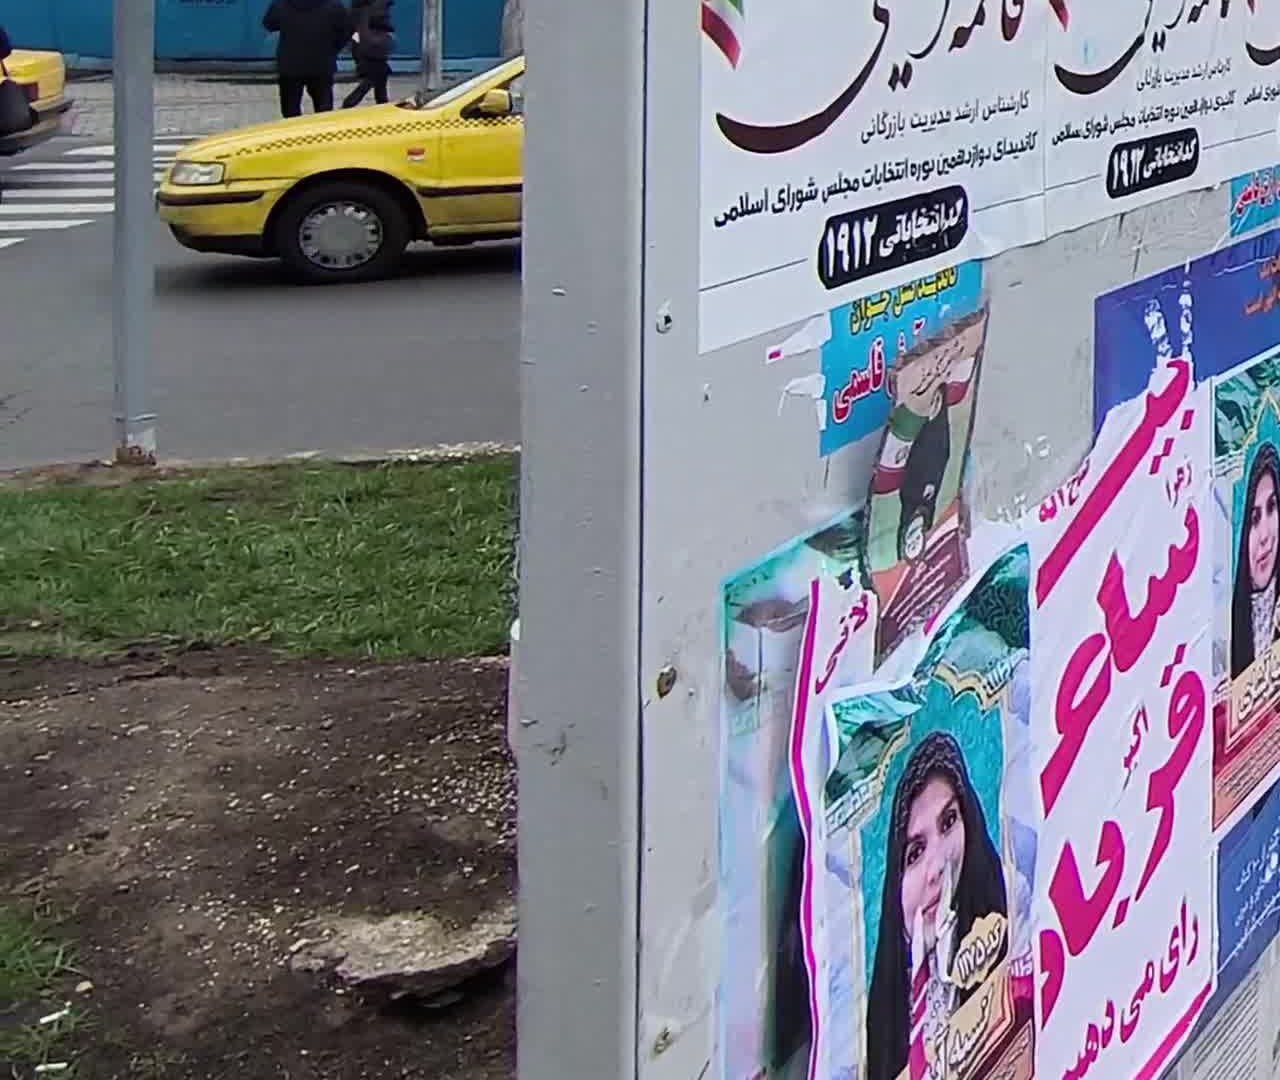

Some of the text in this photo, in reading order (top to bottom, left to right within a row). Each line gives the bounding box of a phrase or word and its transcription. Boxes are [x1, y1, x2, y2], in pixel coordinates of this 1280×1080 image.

[860, 90, 1031, 145] کارشناس ارشد مدیریت بازرگانی
[936, 143, 991, 176] دوازدهمین
[992, 130, 1039, 162] کاندیدای
[861, 159, 909, 192] انتخابات
[909, 157, 936, 184] دوره
[771, 178, 819, 215] شورای
[821, 172, 860, 204] مجلس
[826, 213, 880, 279] ۱۹۱۲
[879, 203, 946, 259] انتخاباتی
